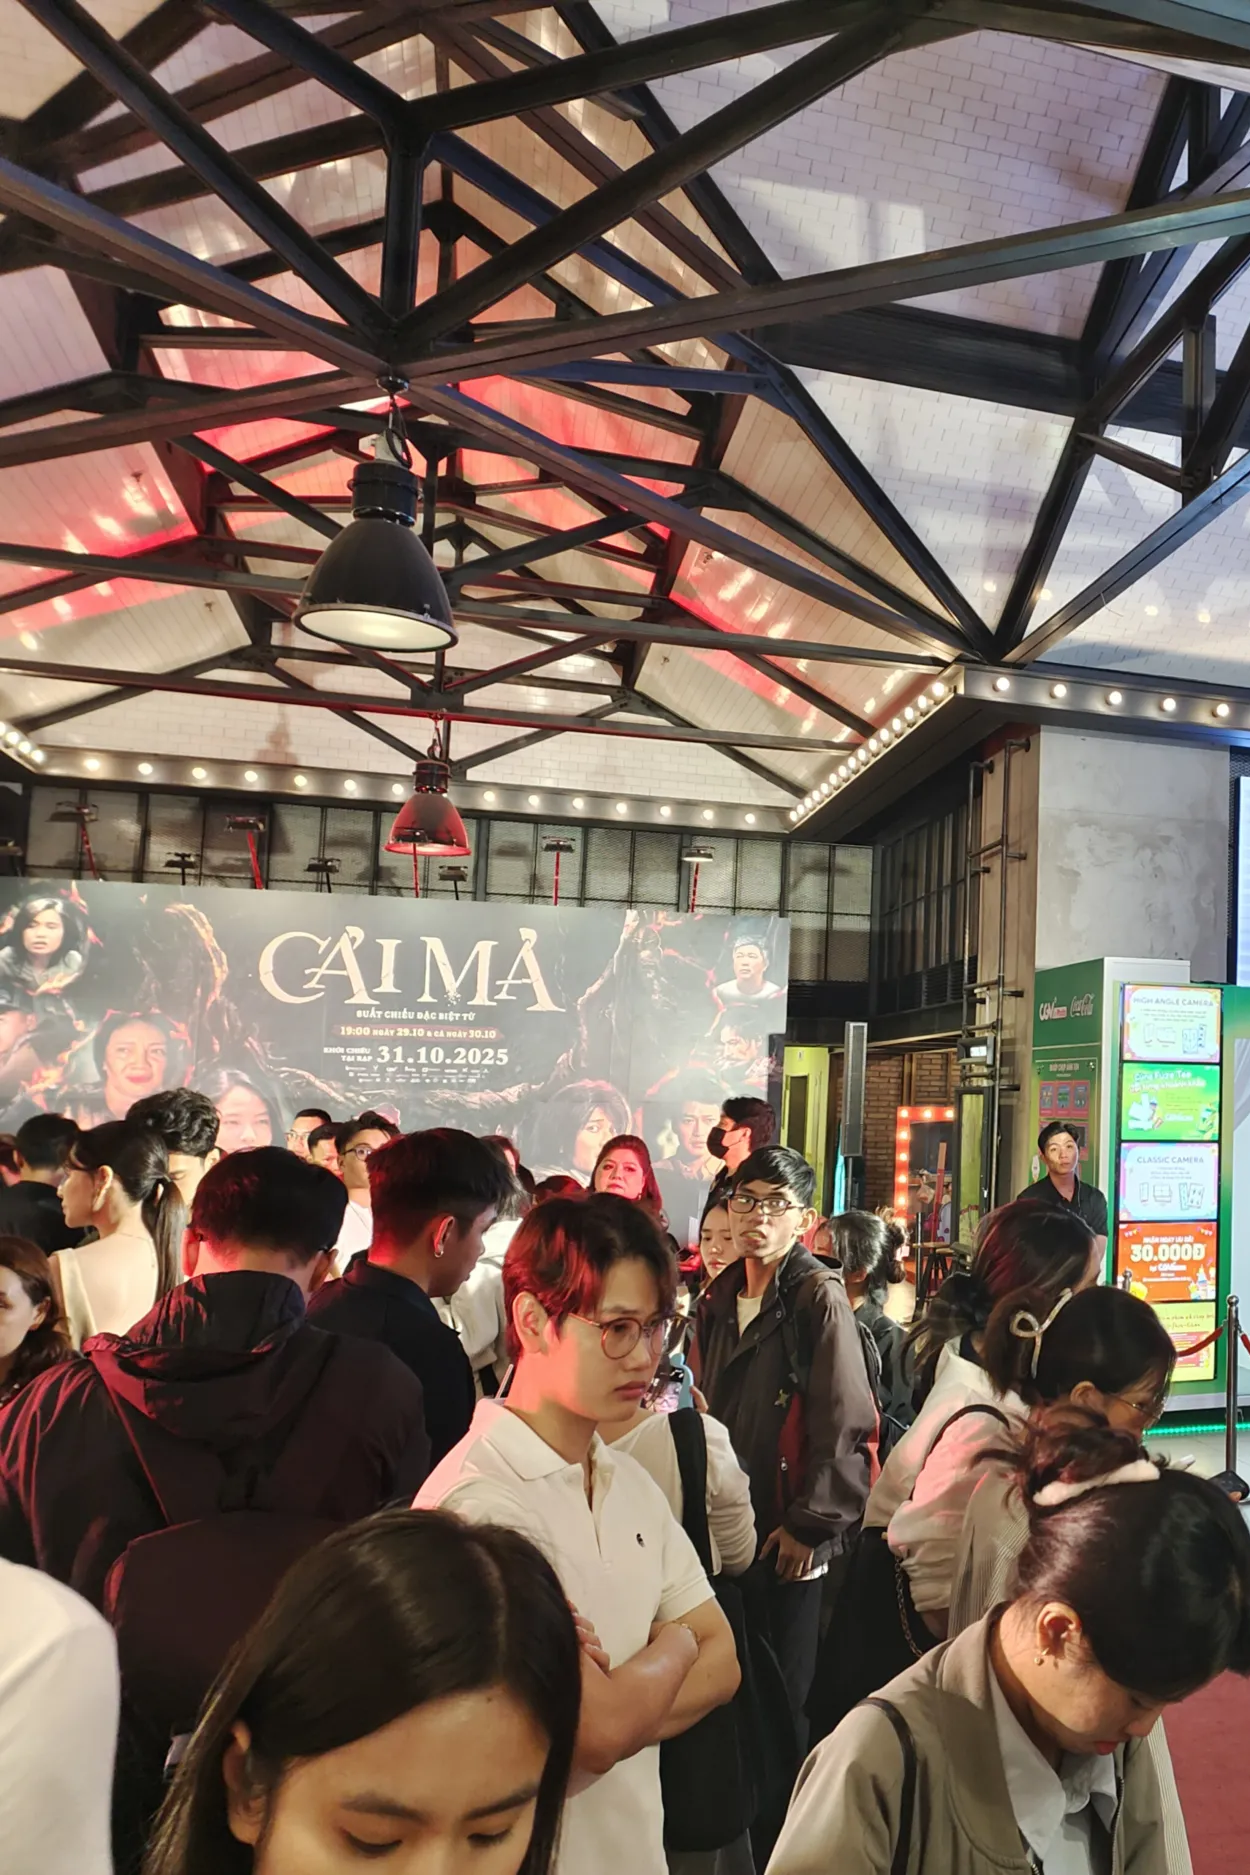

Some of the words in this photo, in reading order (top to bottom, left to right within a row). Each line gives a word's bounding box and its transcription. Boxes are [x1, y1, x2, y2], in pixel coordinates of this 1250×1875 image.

[1133, 997, 1154, 1005] HIGH
[1154, 998, 1179, 1006] ANGLE
[1182, 999, 1214, 1007] CAMERA
[341, 1026, 370, 1036] 19:00
[396, 1027, 424, 1037] 29.10
[469, 1029, 496, 1039] 30.10
[376, 1046, 509, 1065] 31.10.2025
[1136, 1156, 1170, 1164] CLASSIC
[1171, 1156, 1204, 1164] CAMERA
